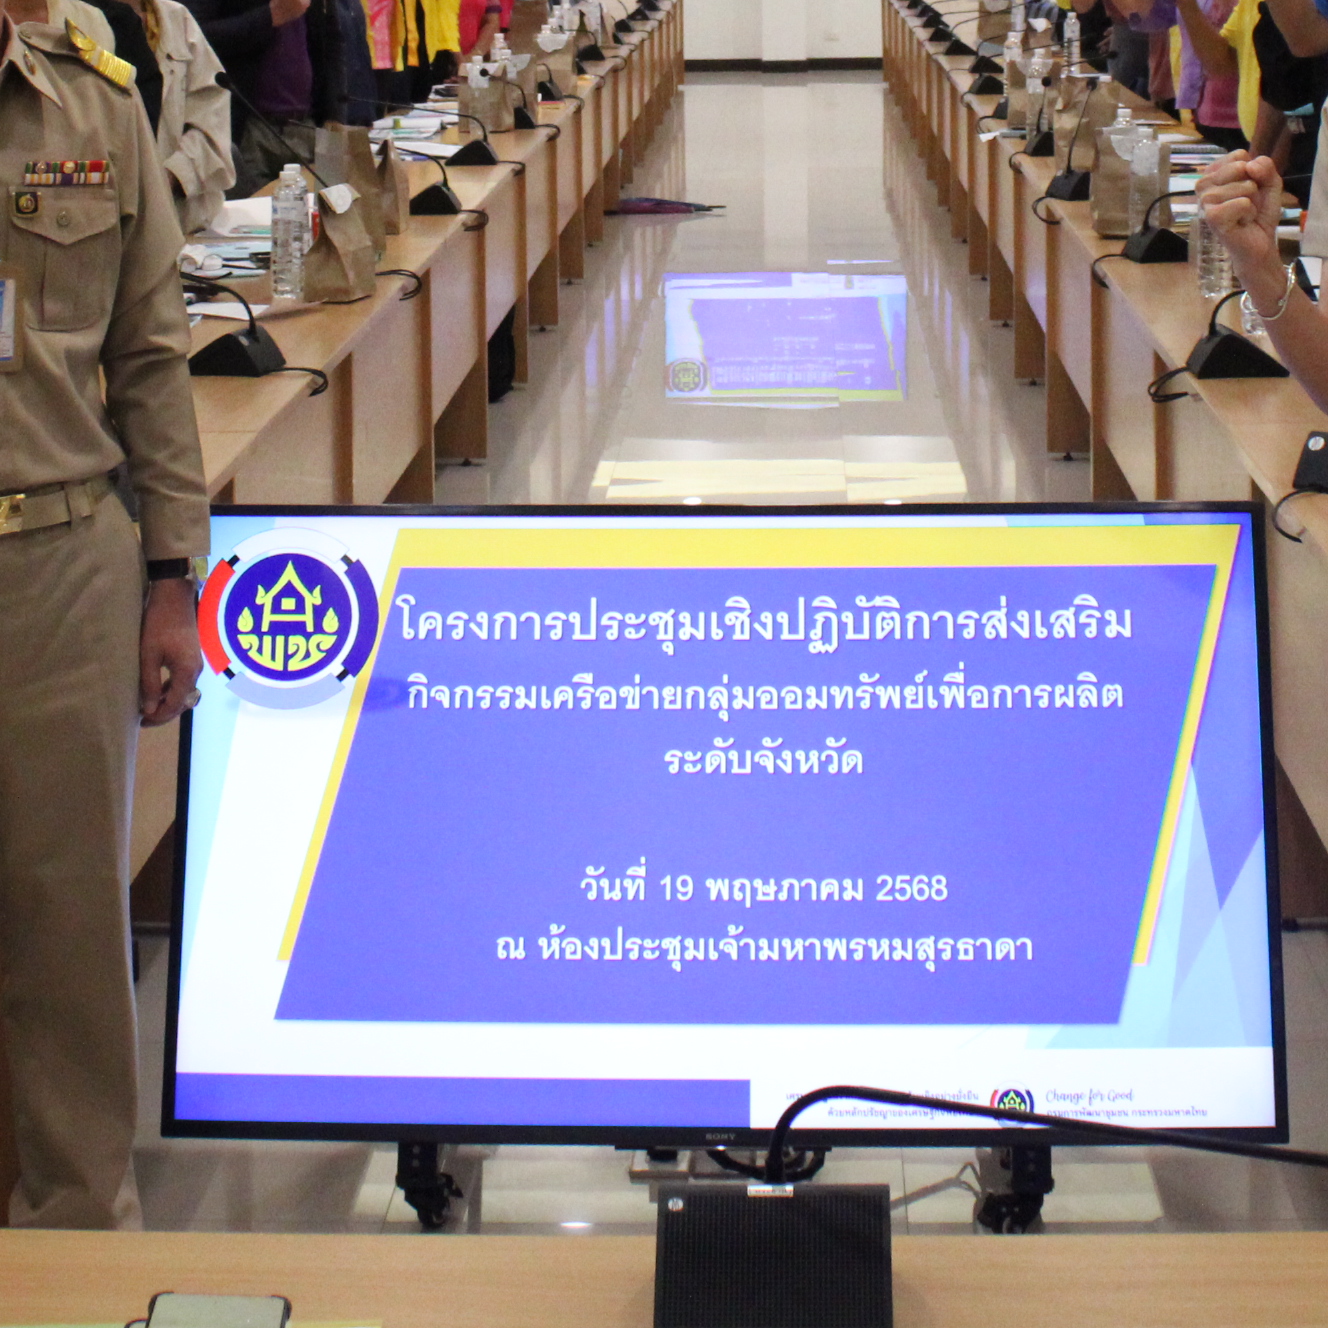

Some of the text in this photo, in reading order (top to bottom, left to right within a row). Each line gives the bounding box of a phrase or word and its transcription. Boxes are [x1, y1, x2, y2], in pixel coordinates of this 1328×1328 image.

[395, 593, 1133, 656] โครงการประชุมเชิงปฏิบัติการส่งเสริม
[407, 661, 1124, 723] กิจกรรมเครือข่ายกลุ่มออมทรัพย์เพื่อการผลิต
[663, 737, 864, 775] ระดับจังหวัด
[580, 856, 949, 909] วันที่ 19 พฤษภาคม 2568
[495, 923, 1033, 972] ณ ห้องประชุมเจ้ามหาพรหมสุรธาดา
[1045, 1087, 1134, 1106] Change for Good
[705, 1132, 736, 1141] SONY
